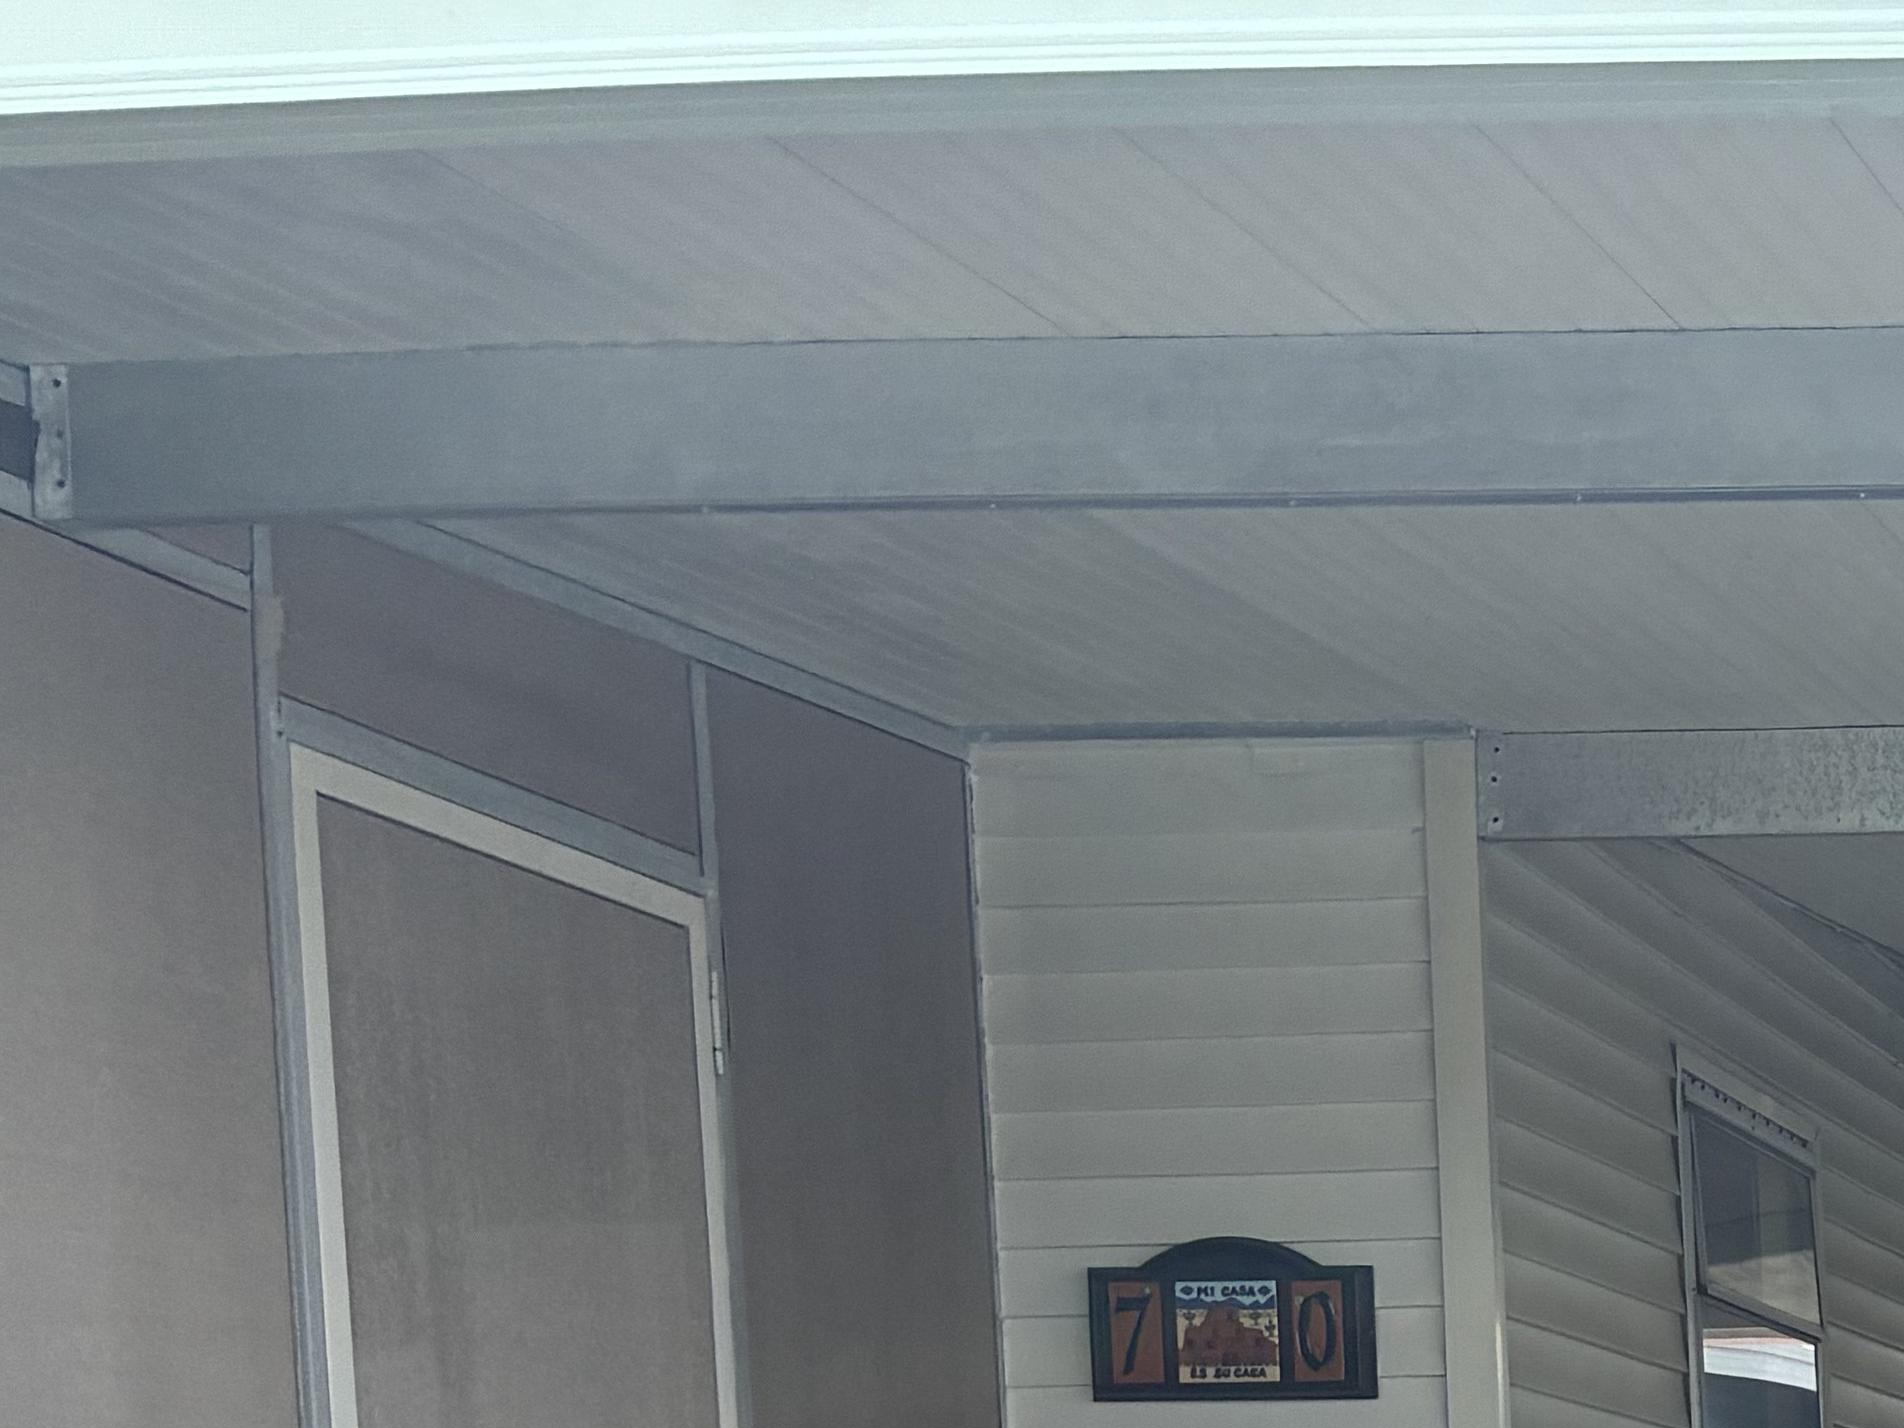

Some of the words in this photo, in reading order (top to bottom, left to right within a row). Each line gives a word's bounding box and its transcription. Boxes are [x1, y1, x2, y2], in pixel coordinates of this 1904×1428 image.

[1196, 1285, 1215, 1298] MI
[1220, 1285, 1257, 1298] CASA
[1114, 1293, 1152, 1376] 7
[1298, 1291, 1337, 1373] 0
[1233, 1366, 1268, 1379] CASA
